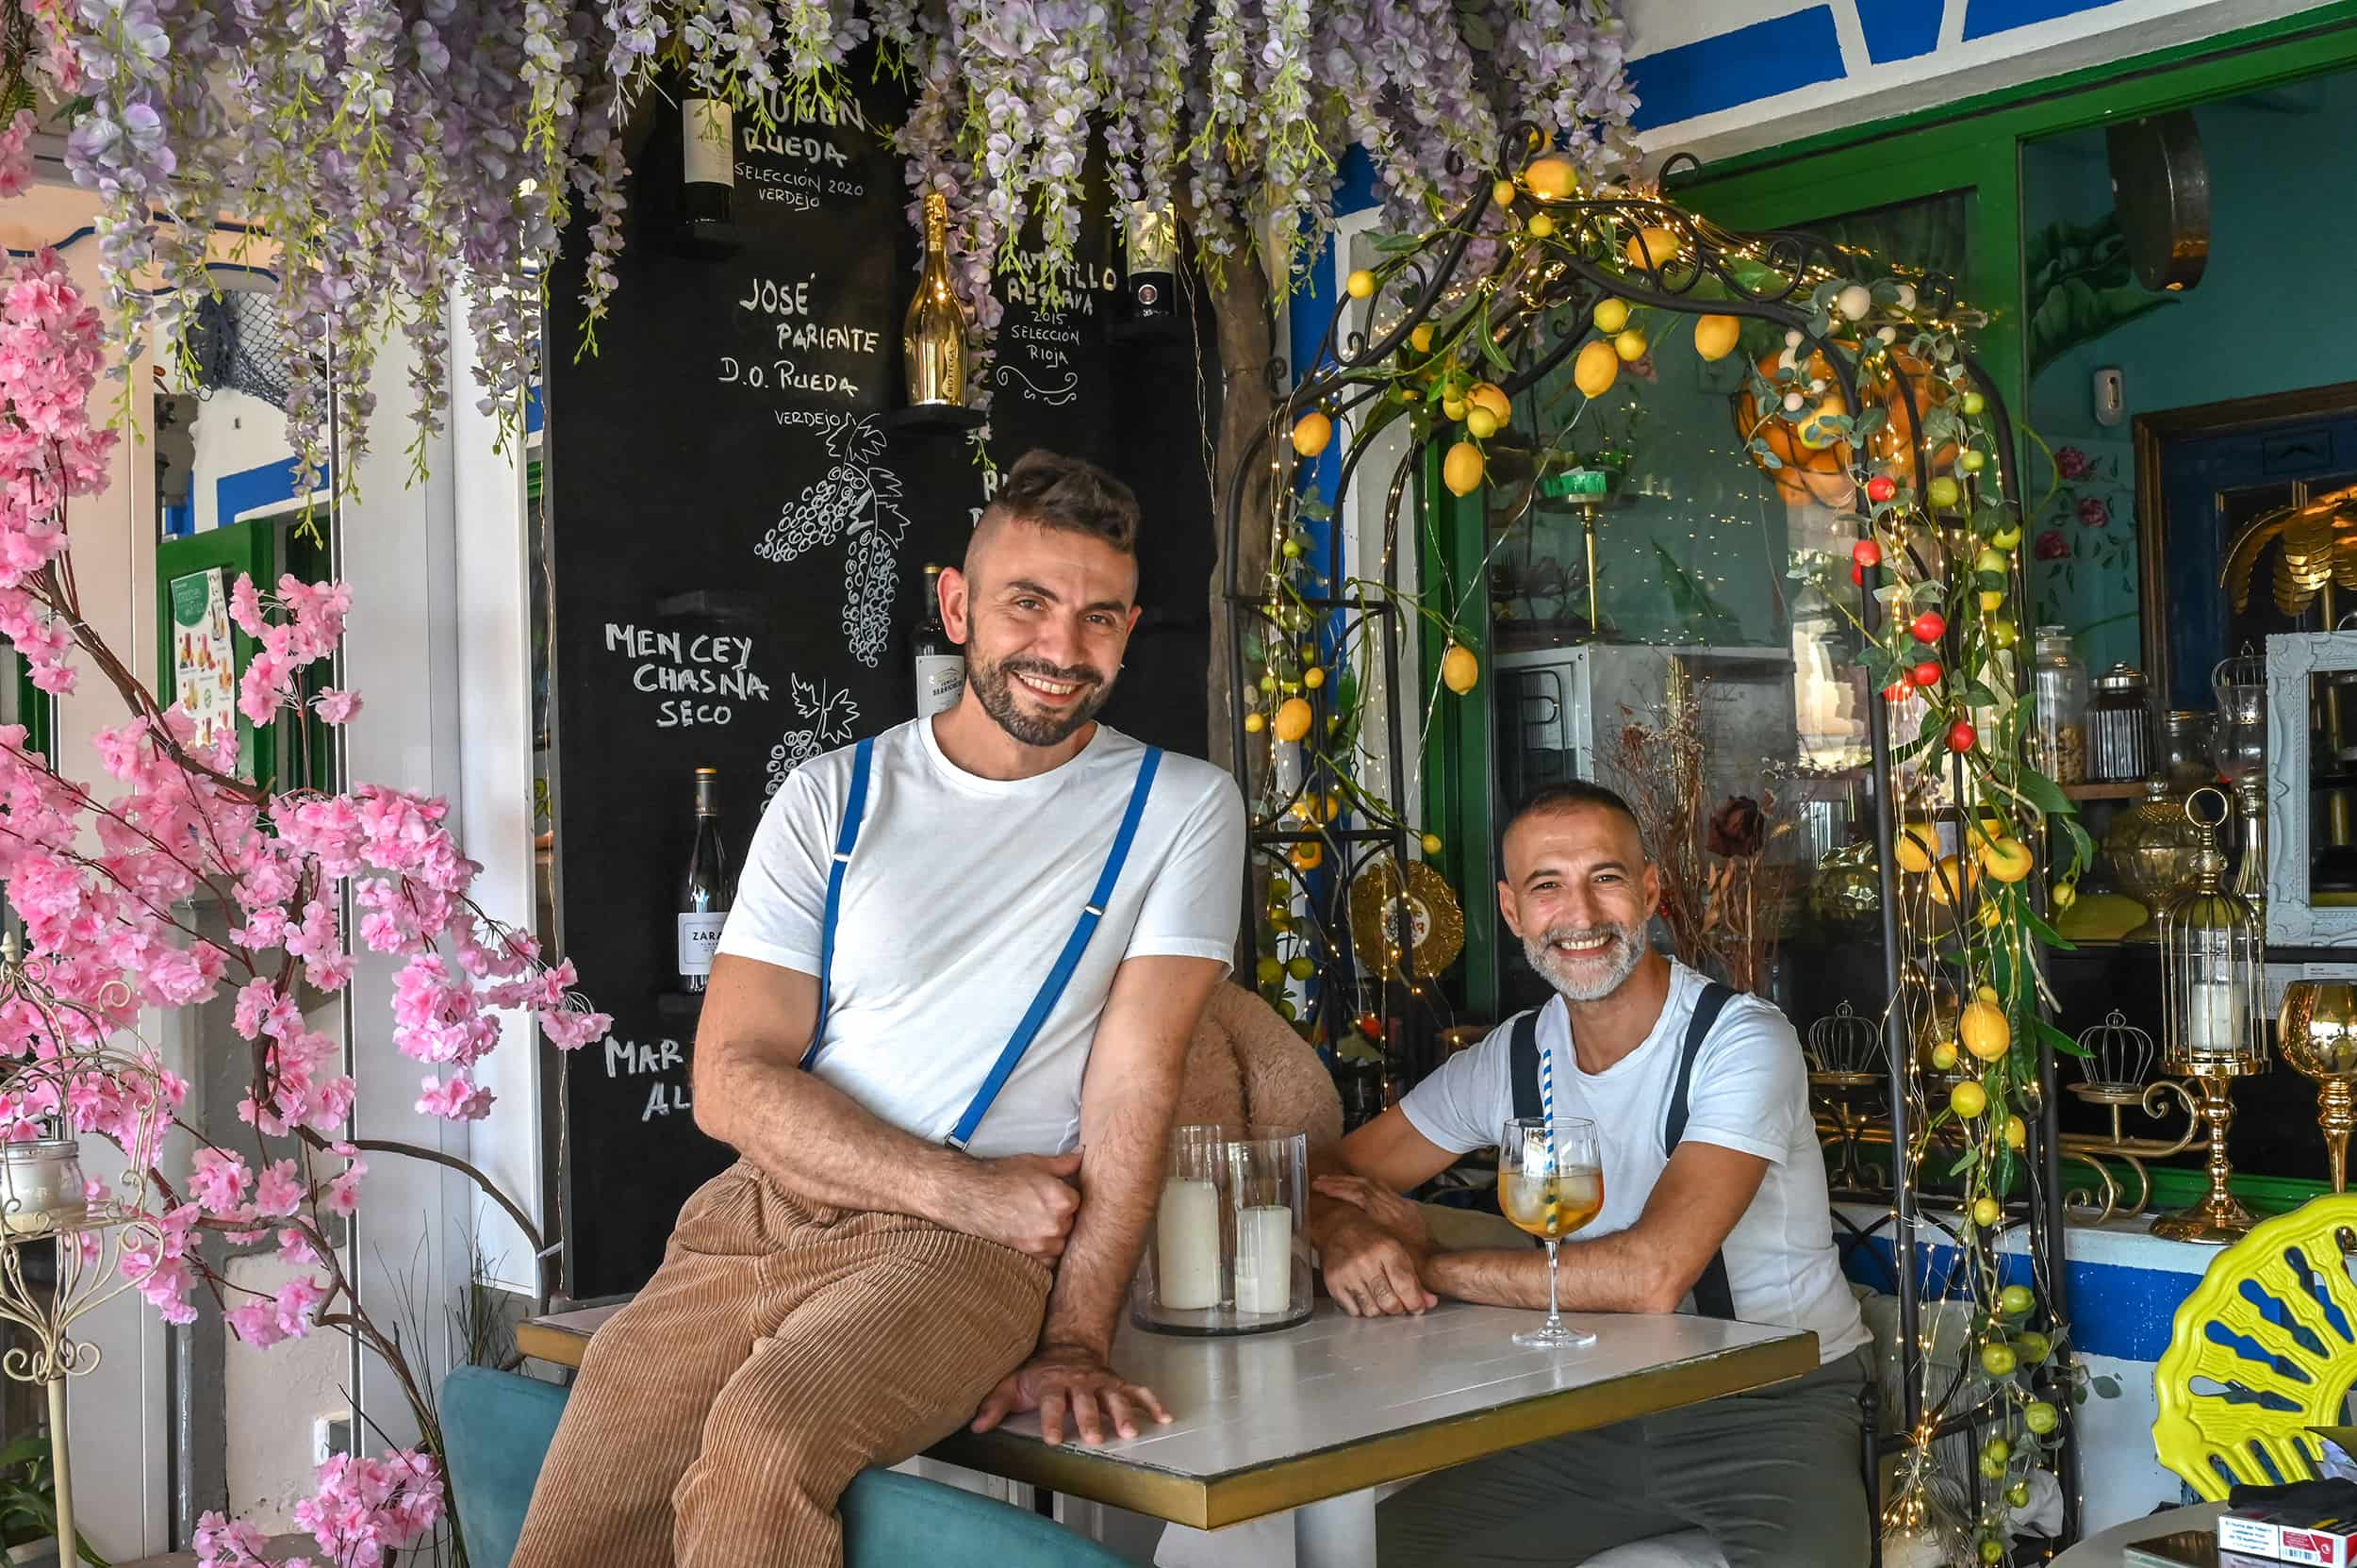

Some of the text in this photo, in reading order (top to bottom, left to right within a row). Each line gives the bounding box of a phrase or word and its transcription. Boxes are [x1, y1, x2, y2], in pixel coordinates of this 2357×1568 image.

[743, 127, 848, 168] RUEDA
[734, 162, 864, 196] SELECCIÓN 2020
[739, 272, 816, 315] JOSÉ
[1008, 277, 1093, 316] RESRVA
[1030, 310, 1068, 325] 2015
[776, 322, 880, 354] PARIENTE
[717, 356, 859, 397] D.O. RUEDA
[633, 663, 770, 701] CHASNA
[655, 700, 732, 727] SECO
